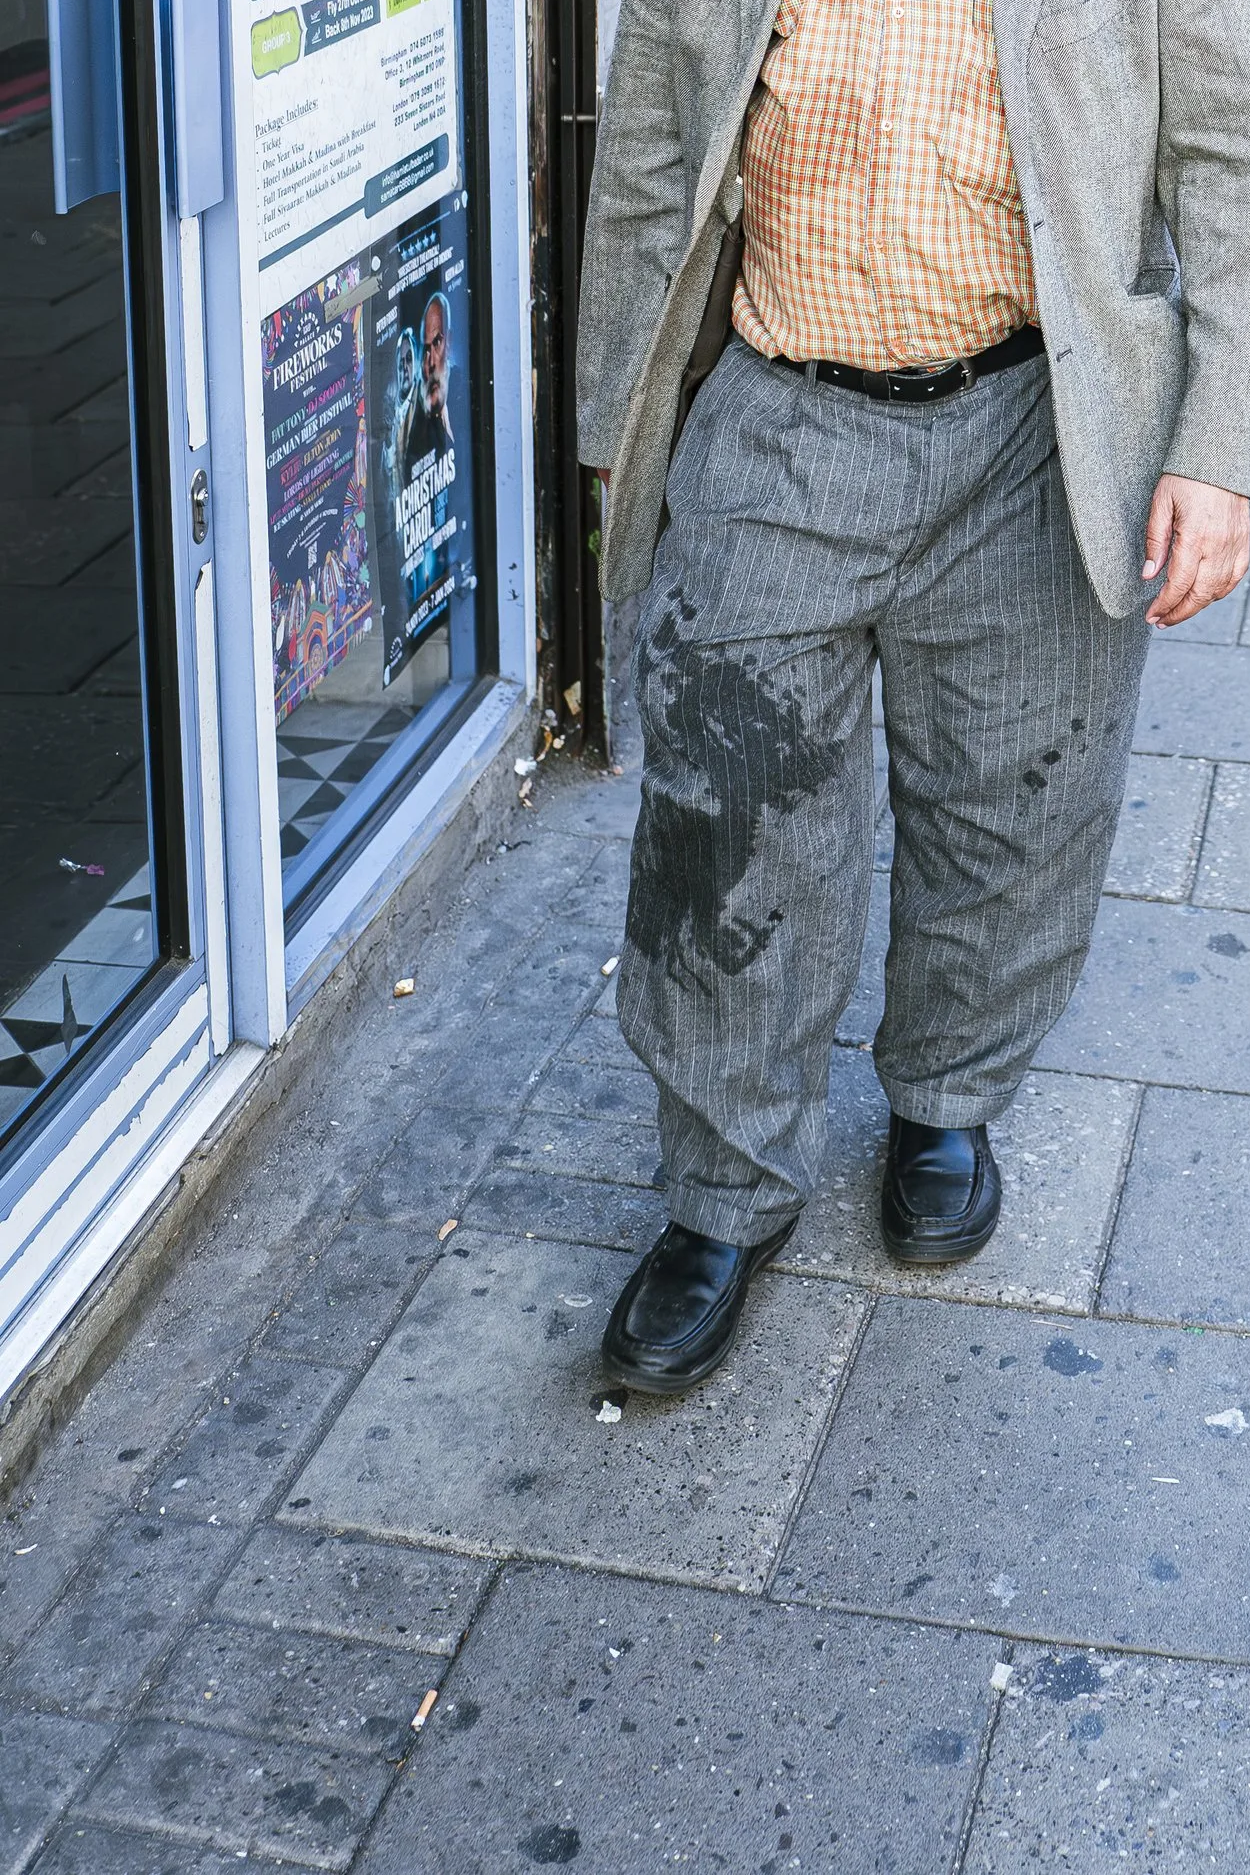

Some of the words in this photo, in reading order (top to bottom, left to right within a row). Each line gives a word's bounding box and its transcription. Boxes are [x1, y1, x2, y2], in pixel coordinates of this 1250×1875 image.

[325, 20, 340, 39] Back
[350, 13, 360, 28] Nov
[361, 5, 374, 23] 2023
[327, 1, 337, 17] Fly
[262, 36, 285, 54] GROUP
[255, 116, 284, 138] Package
[286, 98, 319, 122] Includes:
[262, 137, 281, 153] Ticket
[262, 158, 275, 171] One
[277, 150, 290, 163] Year
[291, 143, 304, 156] Visa
[263, 170, 280, 189] Hotel
[281, 158, 307, 179] Makkah
[337, 134, 350, 148] with
[351, 120, 376, 140] Breakfast
[263, 192, 275, 207] Full
[277, 169, 321, 198] Transportation
[329, 152, 346, 169] Saudi
[346, 143, 365, 161] Arabia
[305, 180, 329, 201] Makkah
[336, 160, 362, 182] Madinah
[264, 221, 291, 242] Lectures
[273, 323, 342, 391] FIREWORKS
[290, 356, 328, 393] FESTIVAL
[271, 422, 285, 445] FAT
[286, 405, 306, 432] TONY
[307, 396, 318, 416] DJ
[318, 374, 347, 406] SPOONY
[266, 432, 300, 470] GERMAN
[300, 419, 319, 443] BIER
[319, 392, 353, 429] FESTIVAL
[395, 496, 403, 533] A
[401, 448, 456, 524] CHRISTMAS
[403, 502, 435, 559] CAROL
